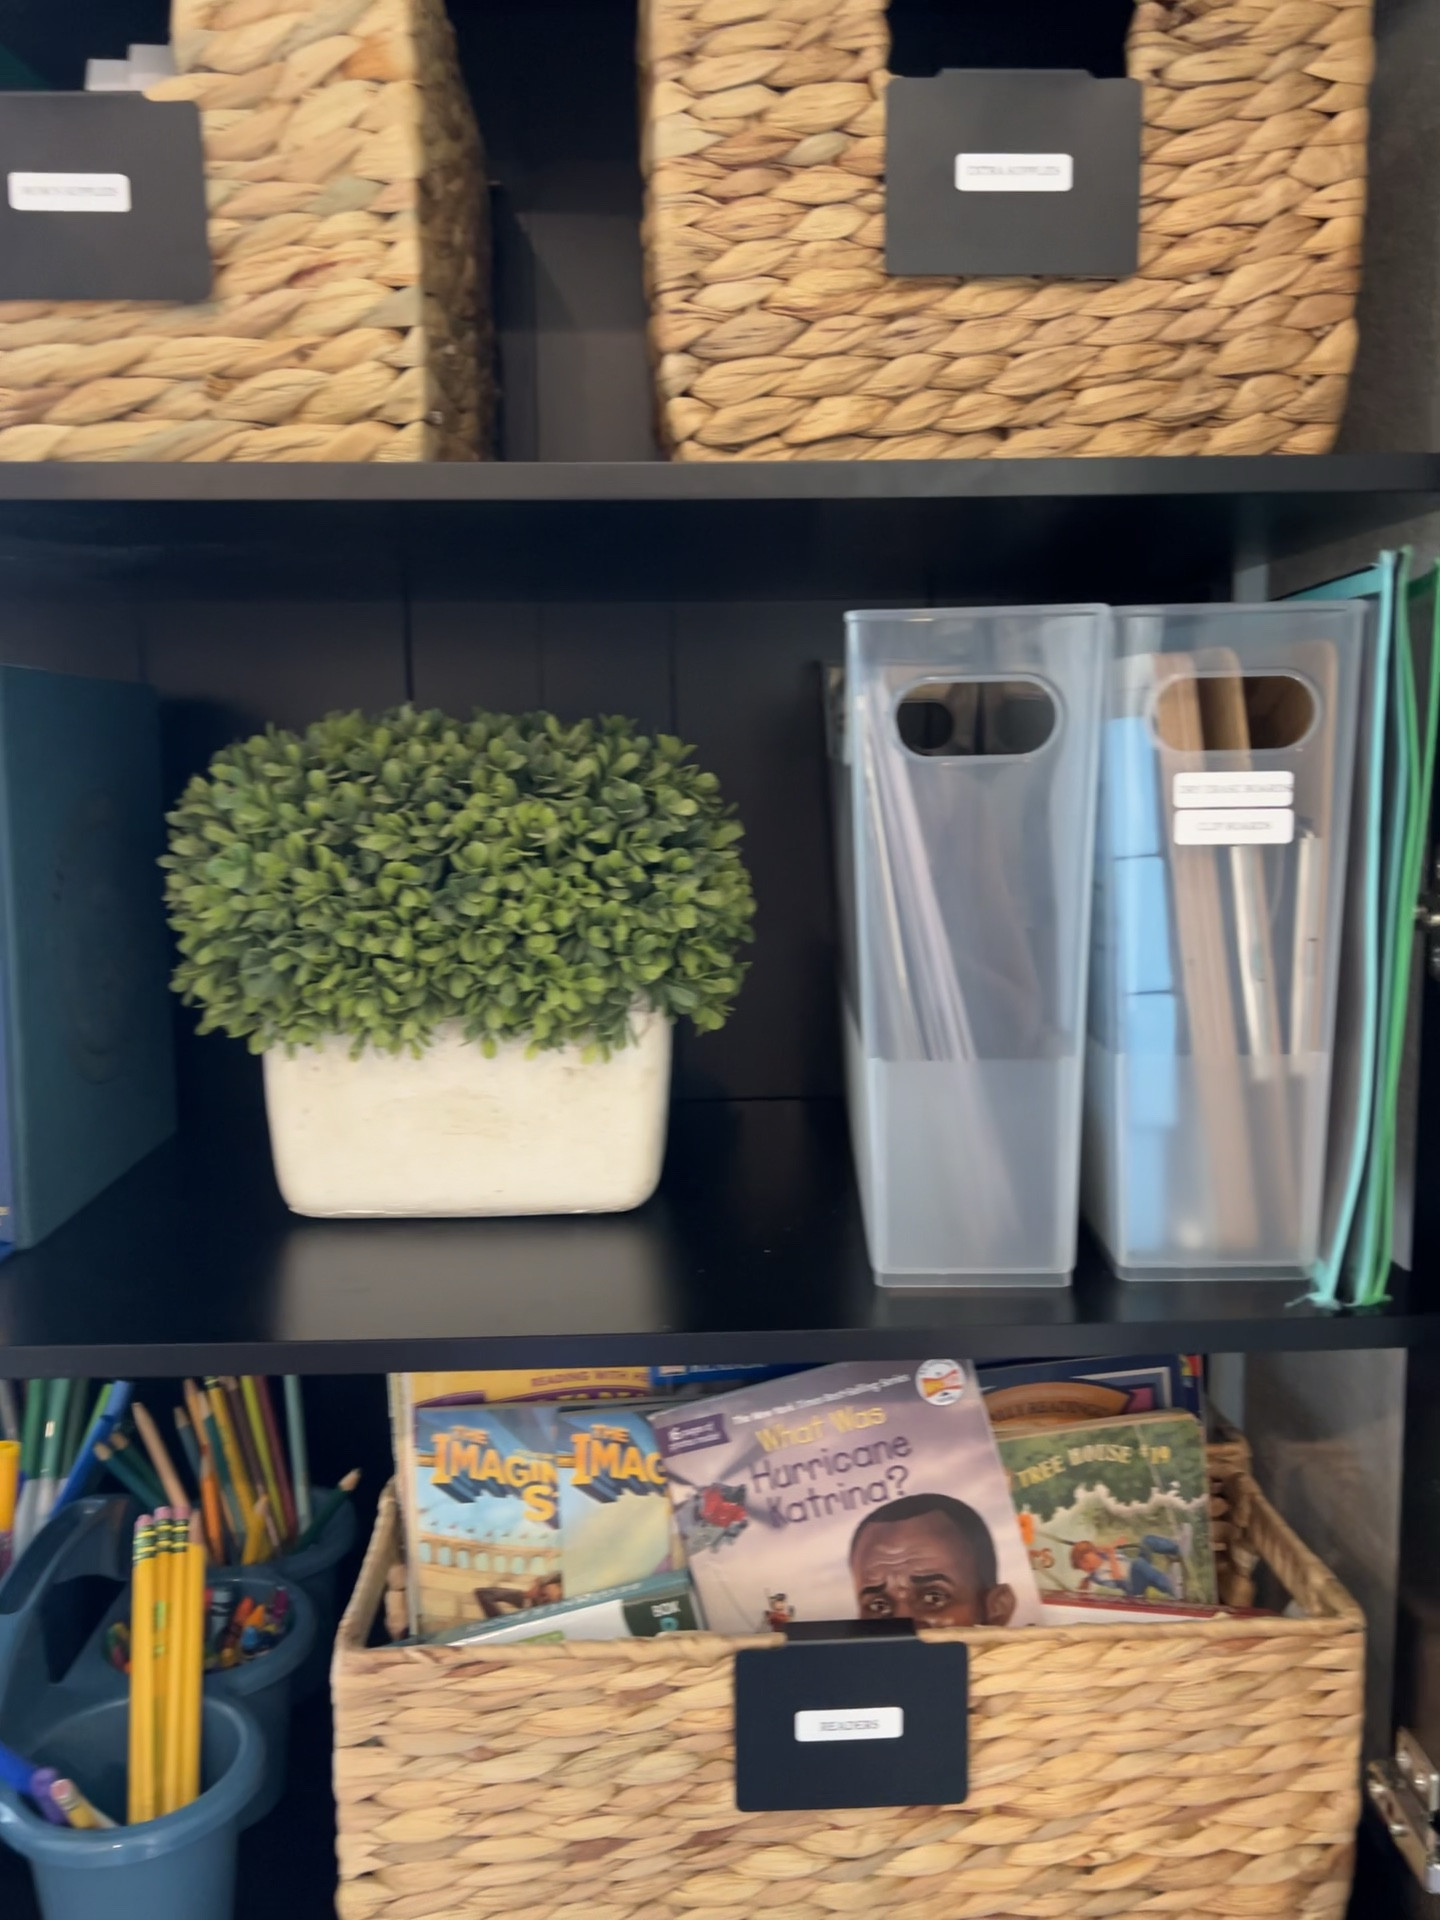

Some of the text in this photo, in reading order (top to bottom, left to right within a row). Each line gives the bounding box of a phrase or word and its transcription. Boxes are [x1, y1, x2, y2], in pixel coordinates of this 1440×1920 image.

[449, 1424, 490, 1445] THE
[590, 1424, 630, 1444] THE
[755, 1416, 824, 1453] What
[827, 1405, 887, 1435] Was
[751, 1434, 914, 1494] Hurricane
[1015, 1455, 1067, 1488] TREE
[1067, 1443, 1133, 1467] HOUSE
[767, 1464, 910, 1529] Katrina?
[651, 1600, 681, 1618] BOX
[819, 1719, 881, 1732] READERS
